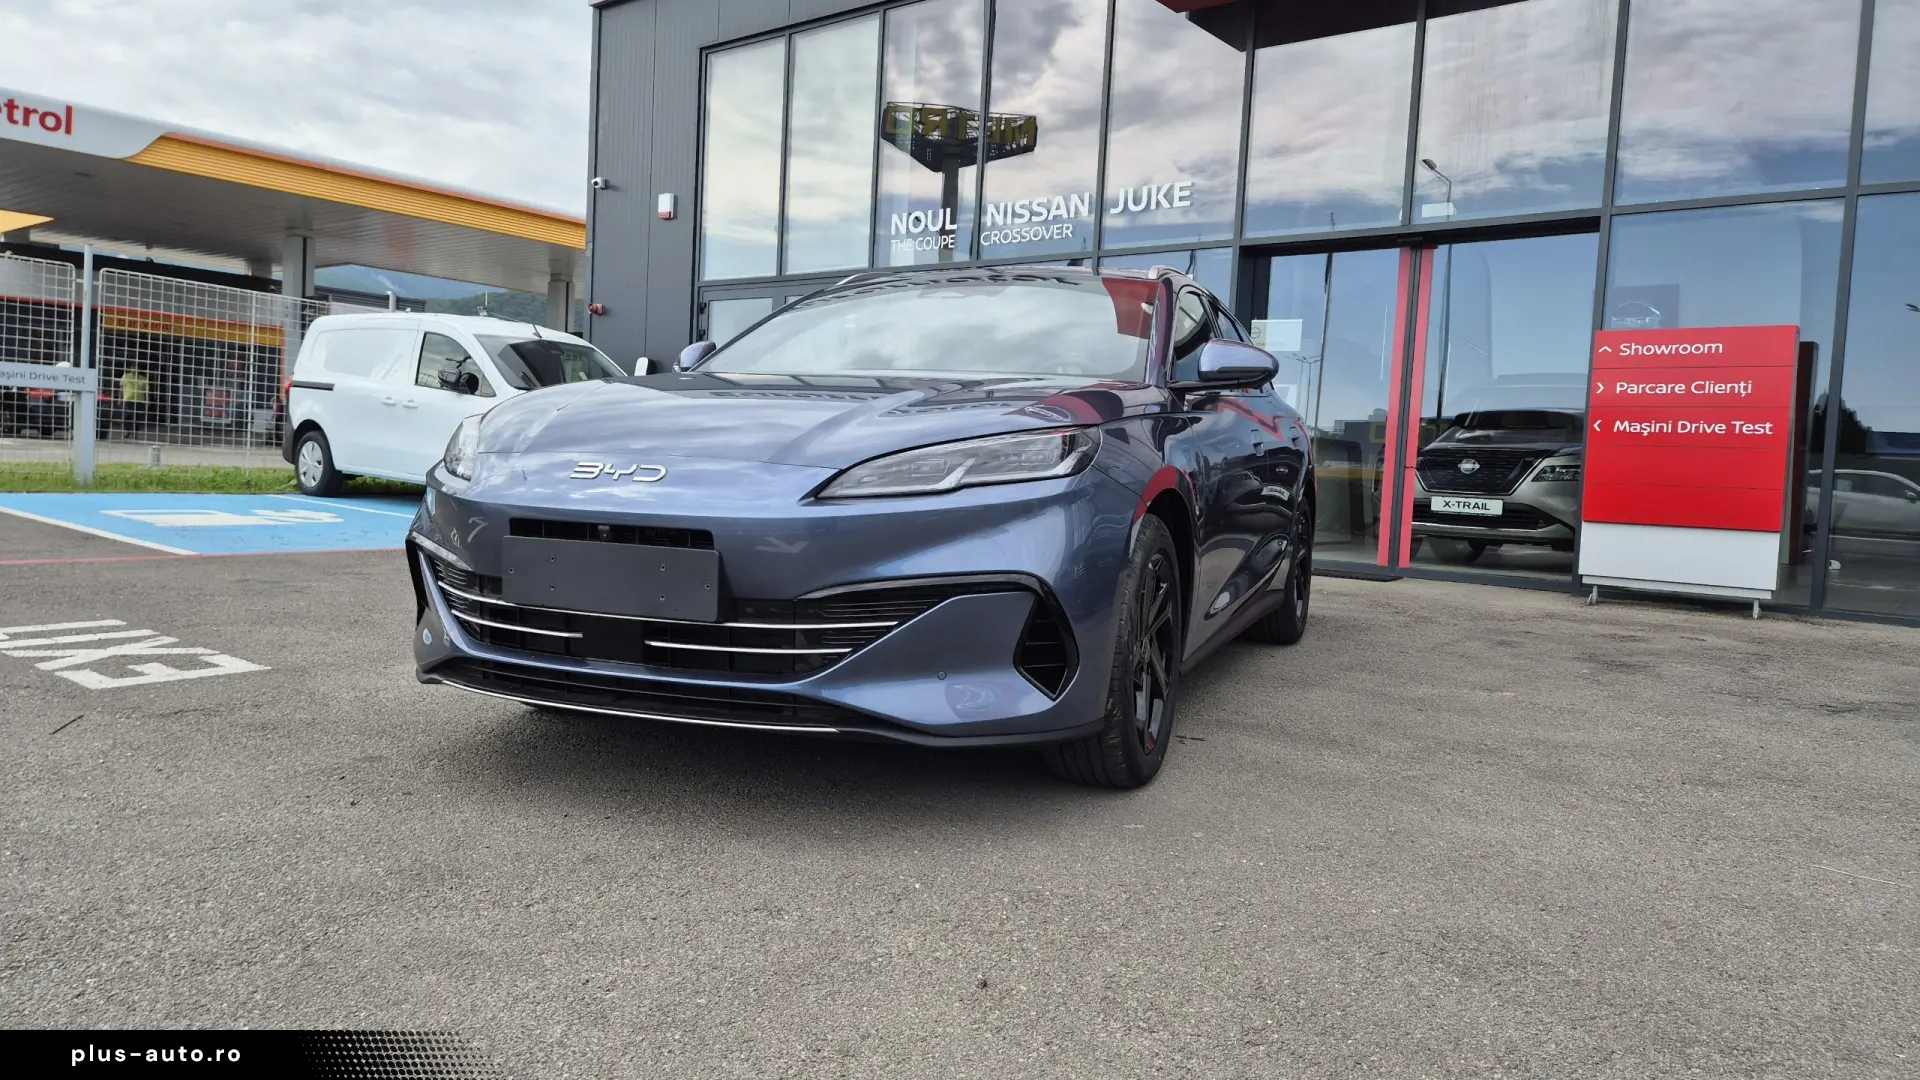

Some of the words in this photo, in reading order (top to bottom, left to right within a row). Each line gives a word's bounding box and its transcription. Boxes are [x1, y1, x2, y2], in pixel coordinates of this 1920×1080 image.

[0, 98, 73, 135] trol
[891, 207, 958, 235] NOUL
[986, 192, 1091, 228] NISSAN
[1109, 181, 1195, 214] JUKE
[891, 238, 914, 252] THE
[915, 235, 956, 251] COUPE
[980, 223, 1073, 246] CROSSOVER
[1618, 342, 1723, 356] Showroom
[29, 371, 59, 382] Drive
[62, 374, 87, 384] Test
[1615, 381, 1686, 395] Parcare
[1677, 420, 1727, 435] Drive
[1731, 420, 1773, 435] Test
[569, 461, 668, 482] BYD
[1442, 500, 1491, 511] X-TRAIL
